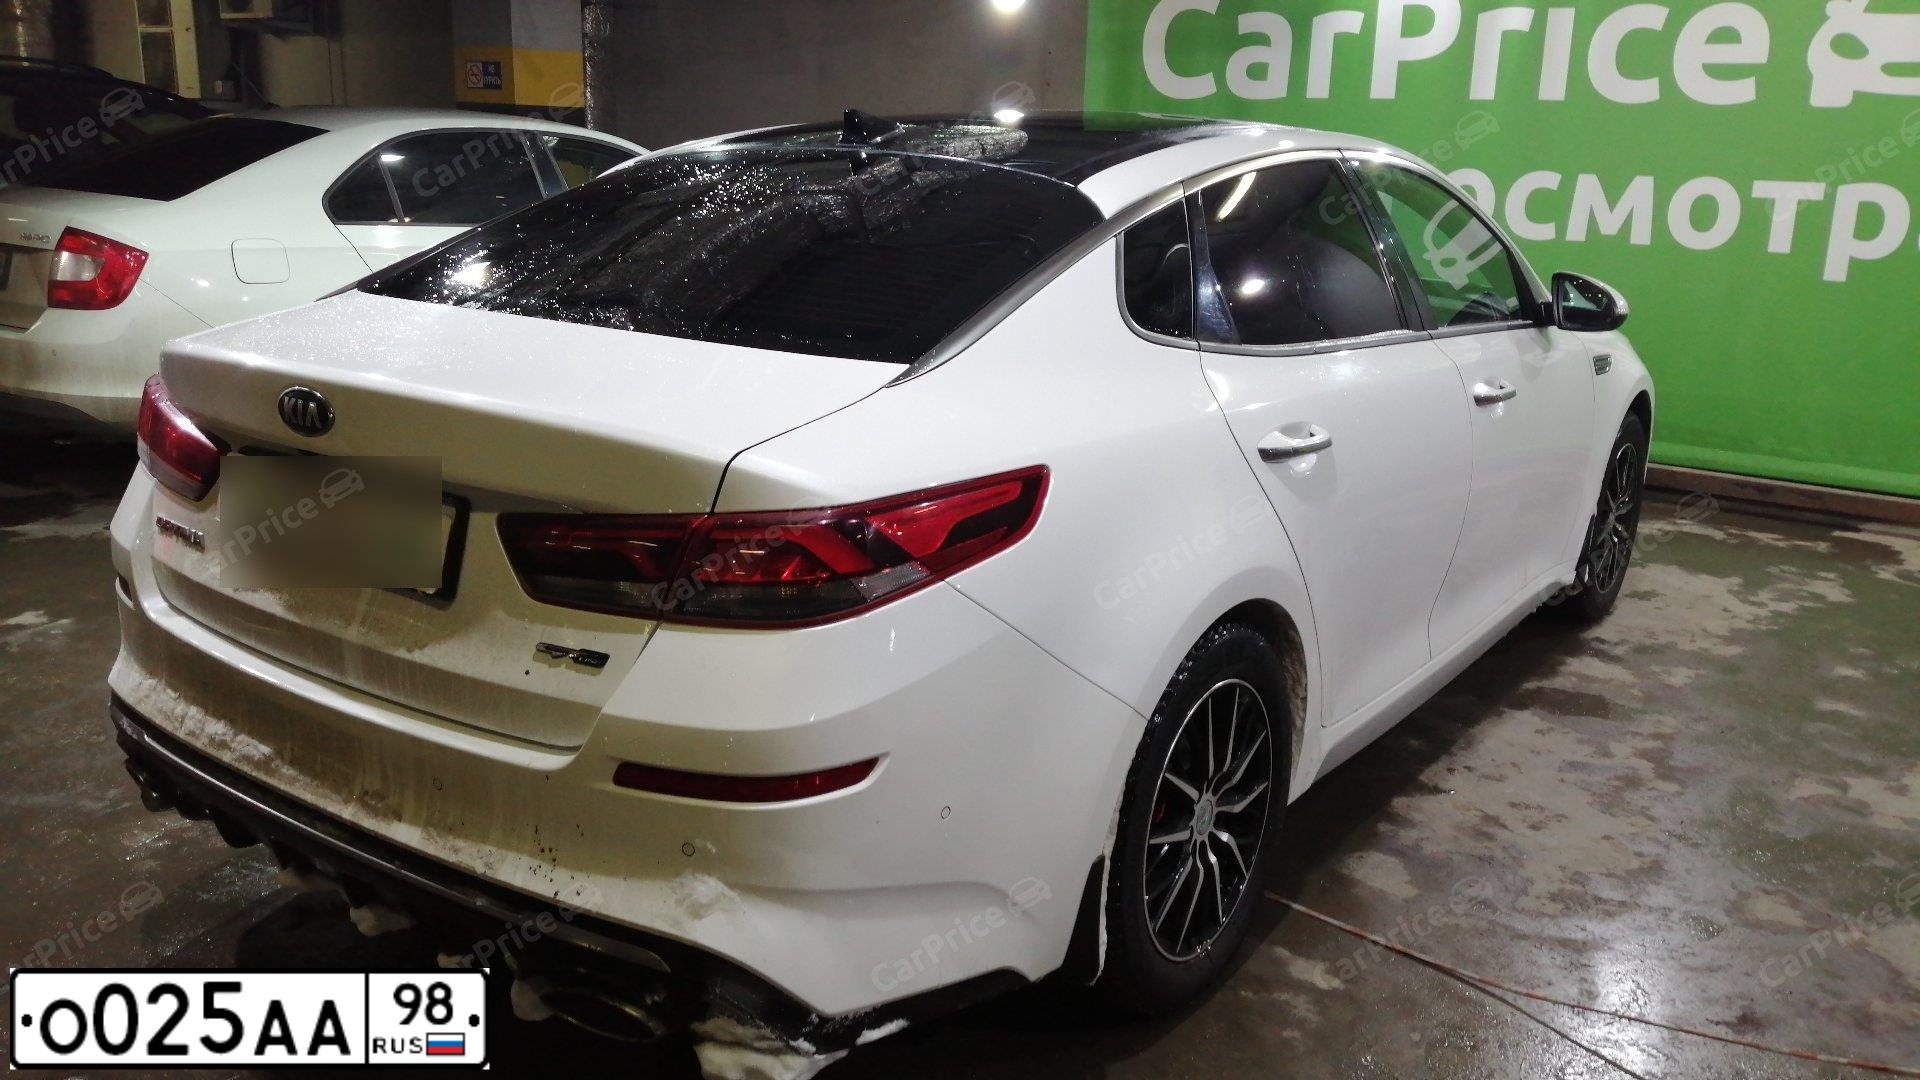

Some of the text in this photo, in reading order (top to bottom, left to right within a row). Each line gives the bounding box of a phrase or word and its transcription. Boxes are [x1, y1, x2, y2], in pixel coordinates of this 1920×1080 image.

[1142, 0, 1770, 105] CarPrice
[1446, 167, 1920, 282] осмотр
[283, 395, 321, 429] KIA
